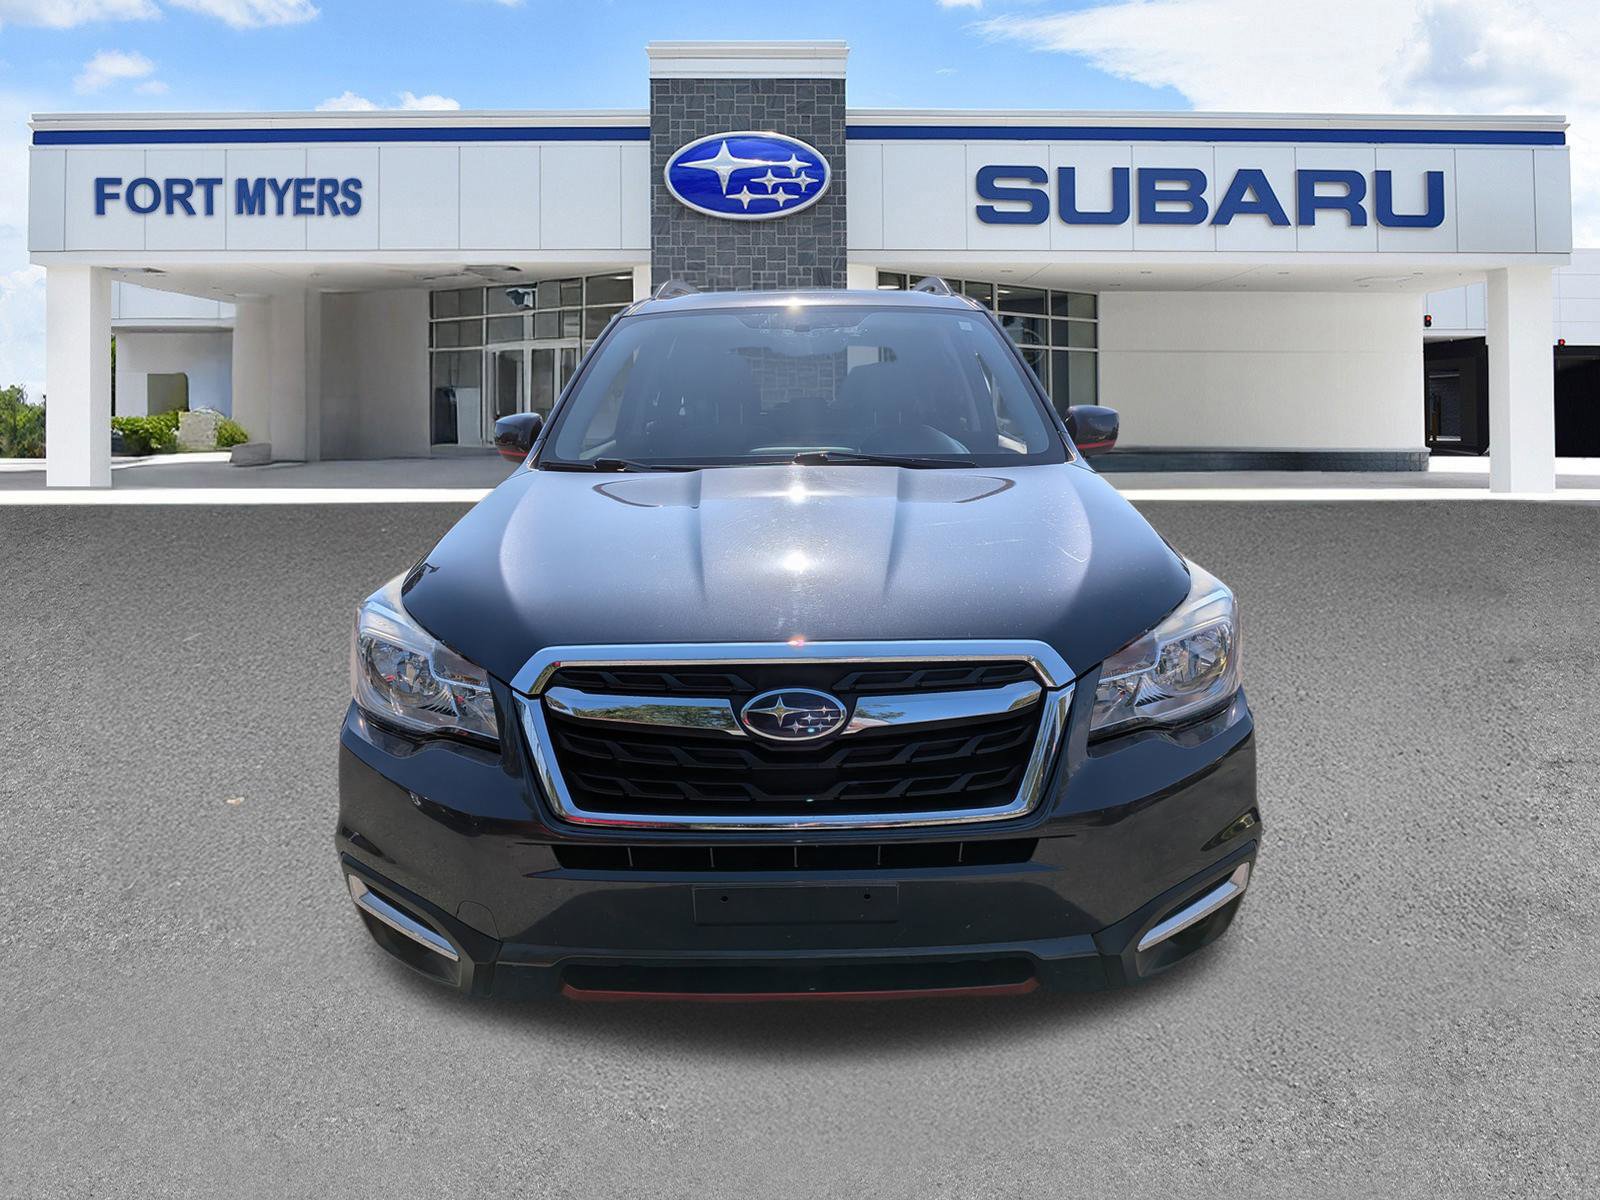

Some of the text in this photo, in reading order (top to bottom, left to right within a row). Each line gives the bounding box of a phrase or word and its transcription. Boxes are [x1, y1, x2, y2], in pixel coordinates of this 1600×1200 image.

[94, 177, 363, 217] FORT MYERS
[975, 164, 1446, 228] SUBARU
